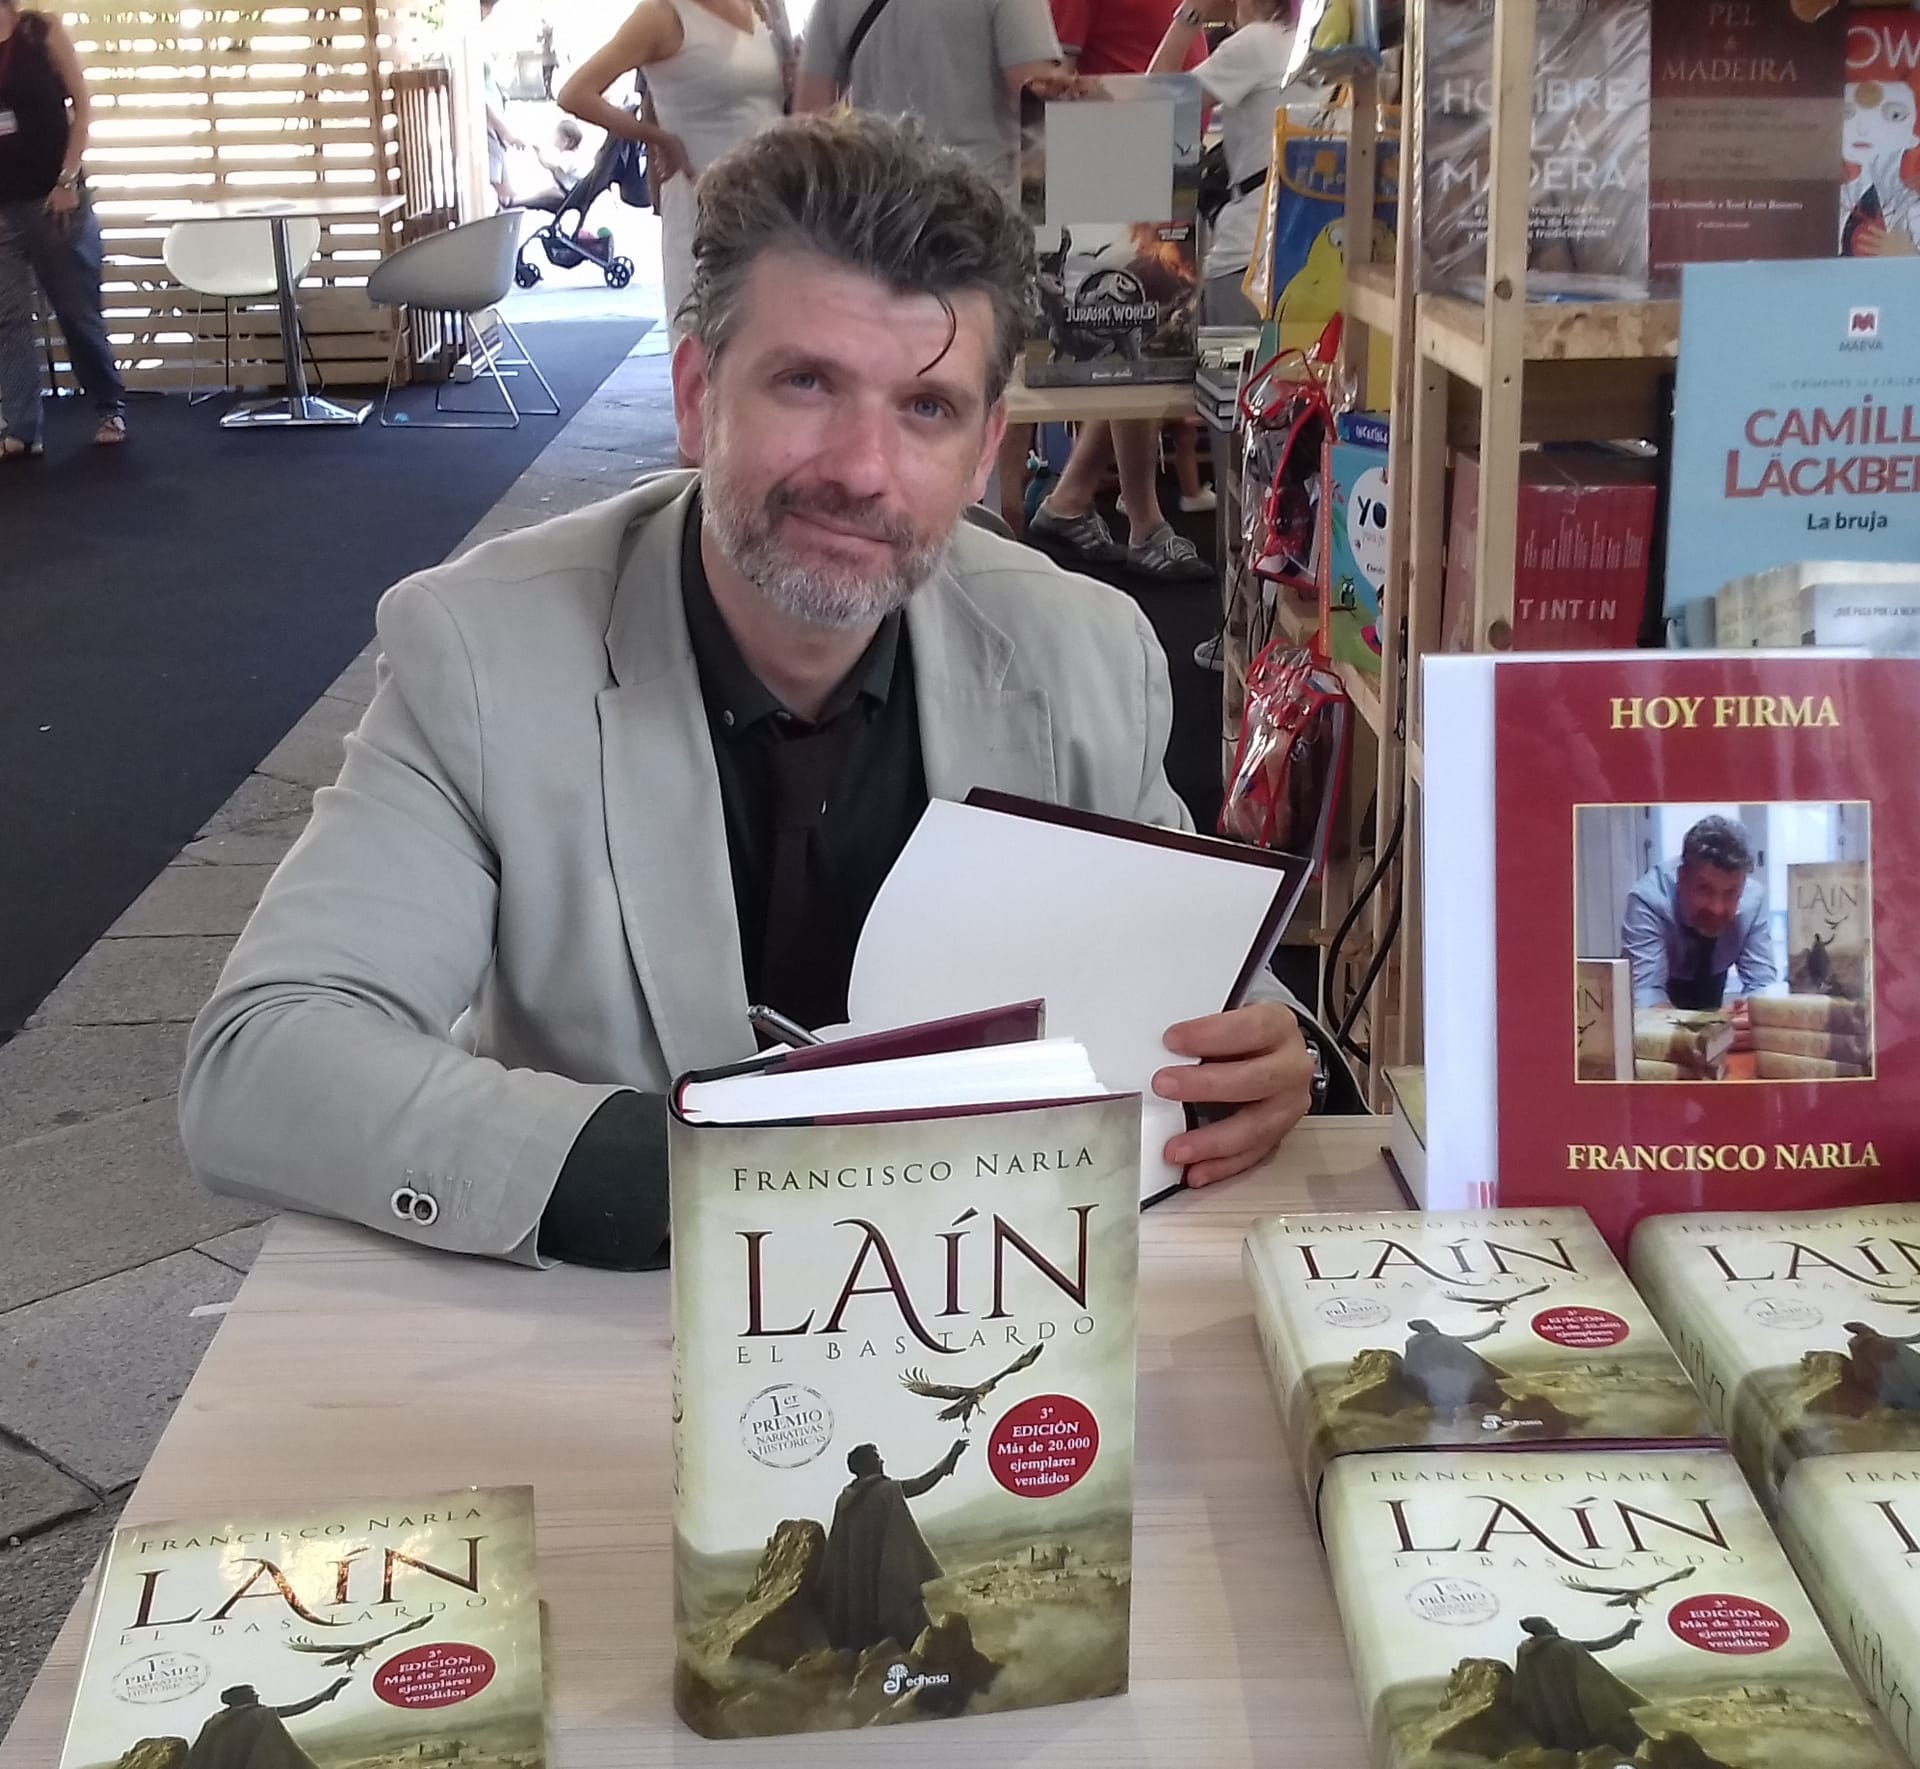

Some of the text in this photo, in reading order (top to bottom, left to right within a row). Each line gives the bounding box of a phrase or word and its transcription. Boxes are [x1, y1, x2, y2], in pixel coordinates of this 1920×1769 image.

[1662, 59, 1799, 82] MADEIRA
[1112, 303, 1156, 321] WORLD
[1839, 340, 1883, 351] MAEVA
[1807, 511, 1888, 532] La bruja
[1519, 599, 1616, 621] TINTIN
[1610, 695, 1840, 729] HOY FIRMA
[1567, 1141, 1880, 1172] FRANCISCO NARLA
[734, 1146, 1095, 1192] FRANCISCO NARLA
[1284, 1219, 1553, 1234] FRANCISCO NARLA
[1681, 1222, 1843, 1234] FRANCISCO
[1291, 1237, 1579, 1286] LAÍN
[735, 1204, 1100, 1354] LAÍN
[737, 1315, 1096, 1364] EL BASTARDO
[752, 1409, 823, 1435] PREMIO
[1012, 1420, 1080, 1438] EDICIÓN
[756, 1423, 823, 1445] NARRATIVAS
[997, 1437, 1090, 1455] Más de 20.000
[1010, 1456, 1076, 1473] ejemplares
[1015, 1472, 1070, 1486] vendidos
[1371, 1471, 1699, 1483] FRANCISCO NARLA
[140, 1507, 481, 1554] FRANCISCO NARLA
[1379, 1495, 1732, 1571] LAÍN
[1394, 1554, 1745, 1568] EL BASTARDO
[123, 1534, 489, 1630] LAÍN
[1418, 1592, 1487, 1606] PREMIO
[119, 1596, 488, 1646] EL BASTARDO
[1689, 1608, 1762, 1619] EDICIÓN
[1680, 1619, 1780, 1629] Más de 20.000
[1697, 1629, 1771, 1640] ejemplares
[1707, 1639, 1770, 1649] vendidos
[400, 1656, 472, 1674] EDICIÓN
[124, 1664, 200, 1686] PREMIO
[384, 1663, 486, 1686] Más de 20.000
[906, 1674, 949, 1687] edhasa
[398, 1676, 472, 1694] ejemplares
[405, 1688, 467, 1704] vendidos
